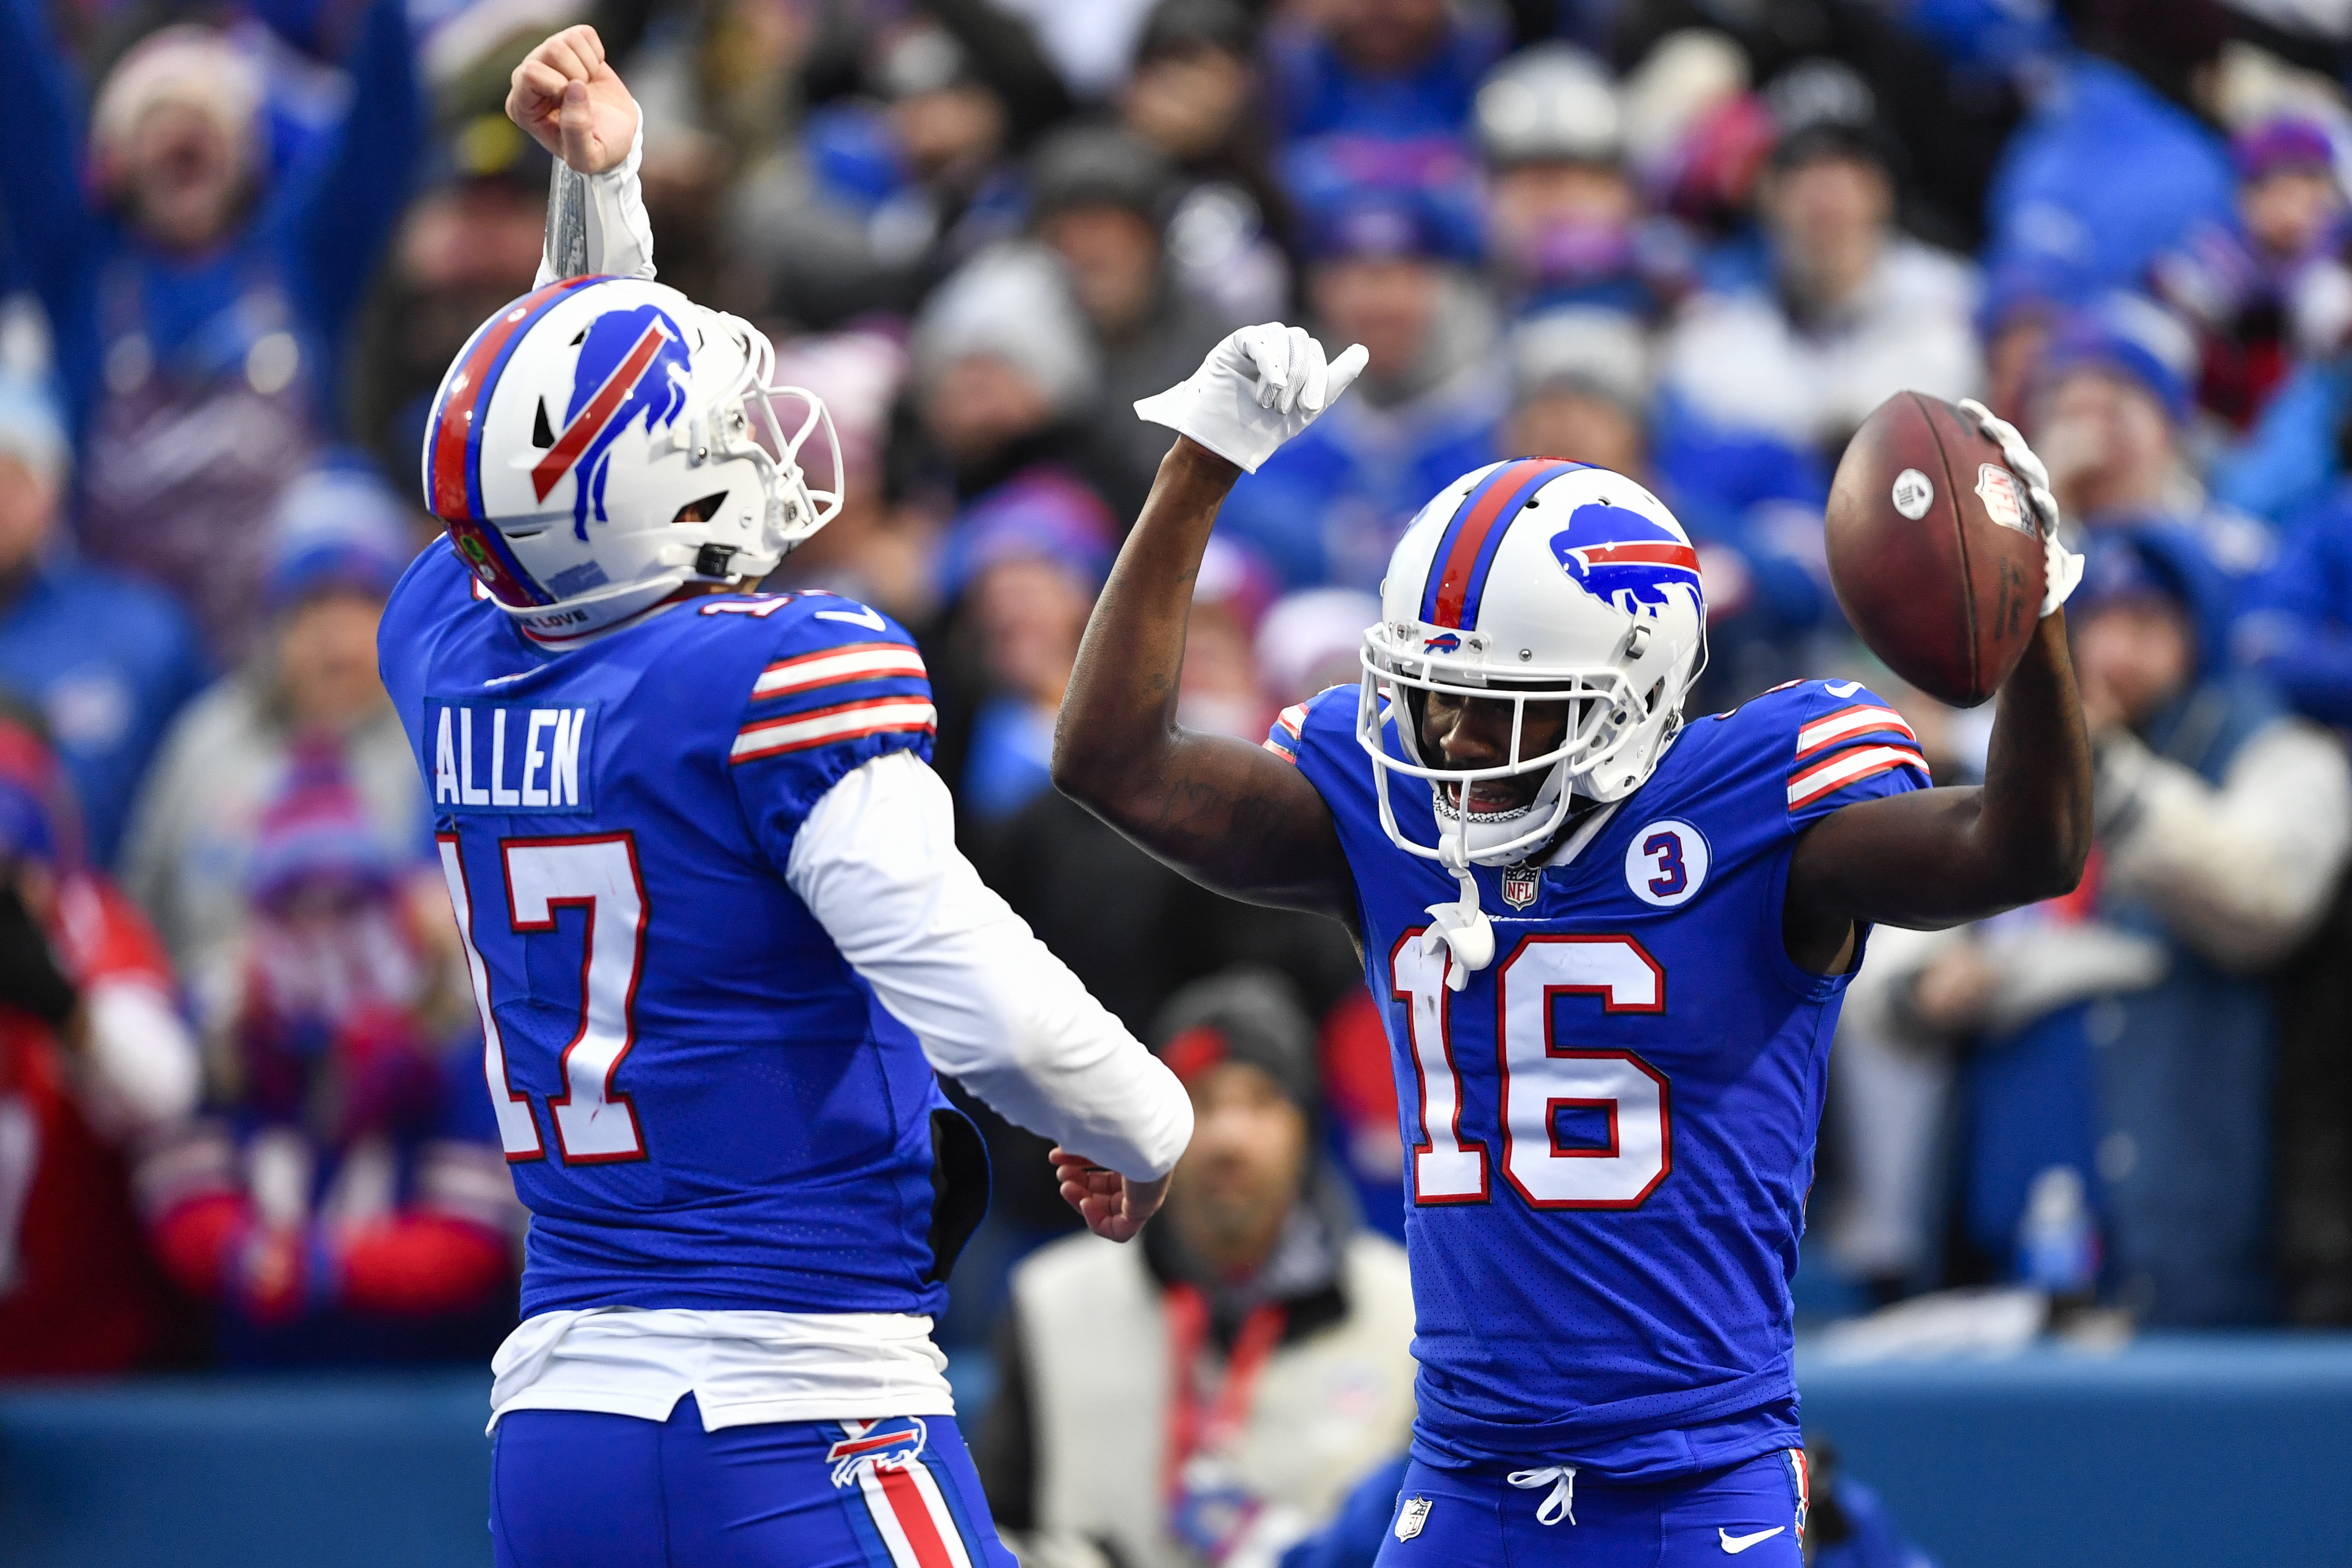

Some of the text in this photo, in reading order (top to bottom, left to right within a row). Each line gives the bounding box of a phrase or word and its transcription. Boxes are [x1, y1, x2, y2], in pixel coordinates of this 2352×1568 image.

[435, 706, 586, 807] ALLEN
[1507, 881, 1532, 902] NFL
[1643, 831, 1688, 898] 3
[435, 829, 650, 1167] 17
[1388, 926, 1674, 1211] 16
